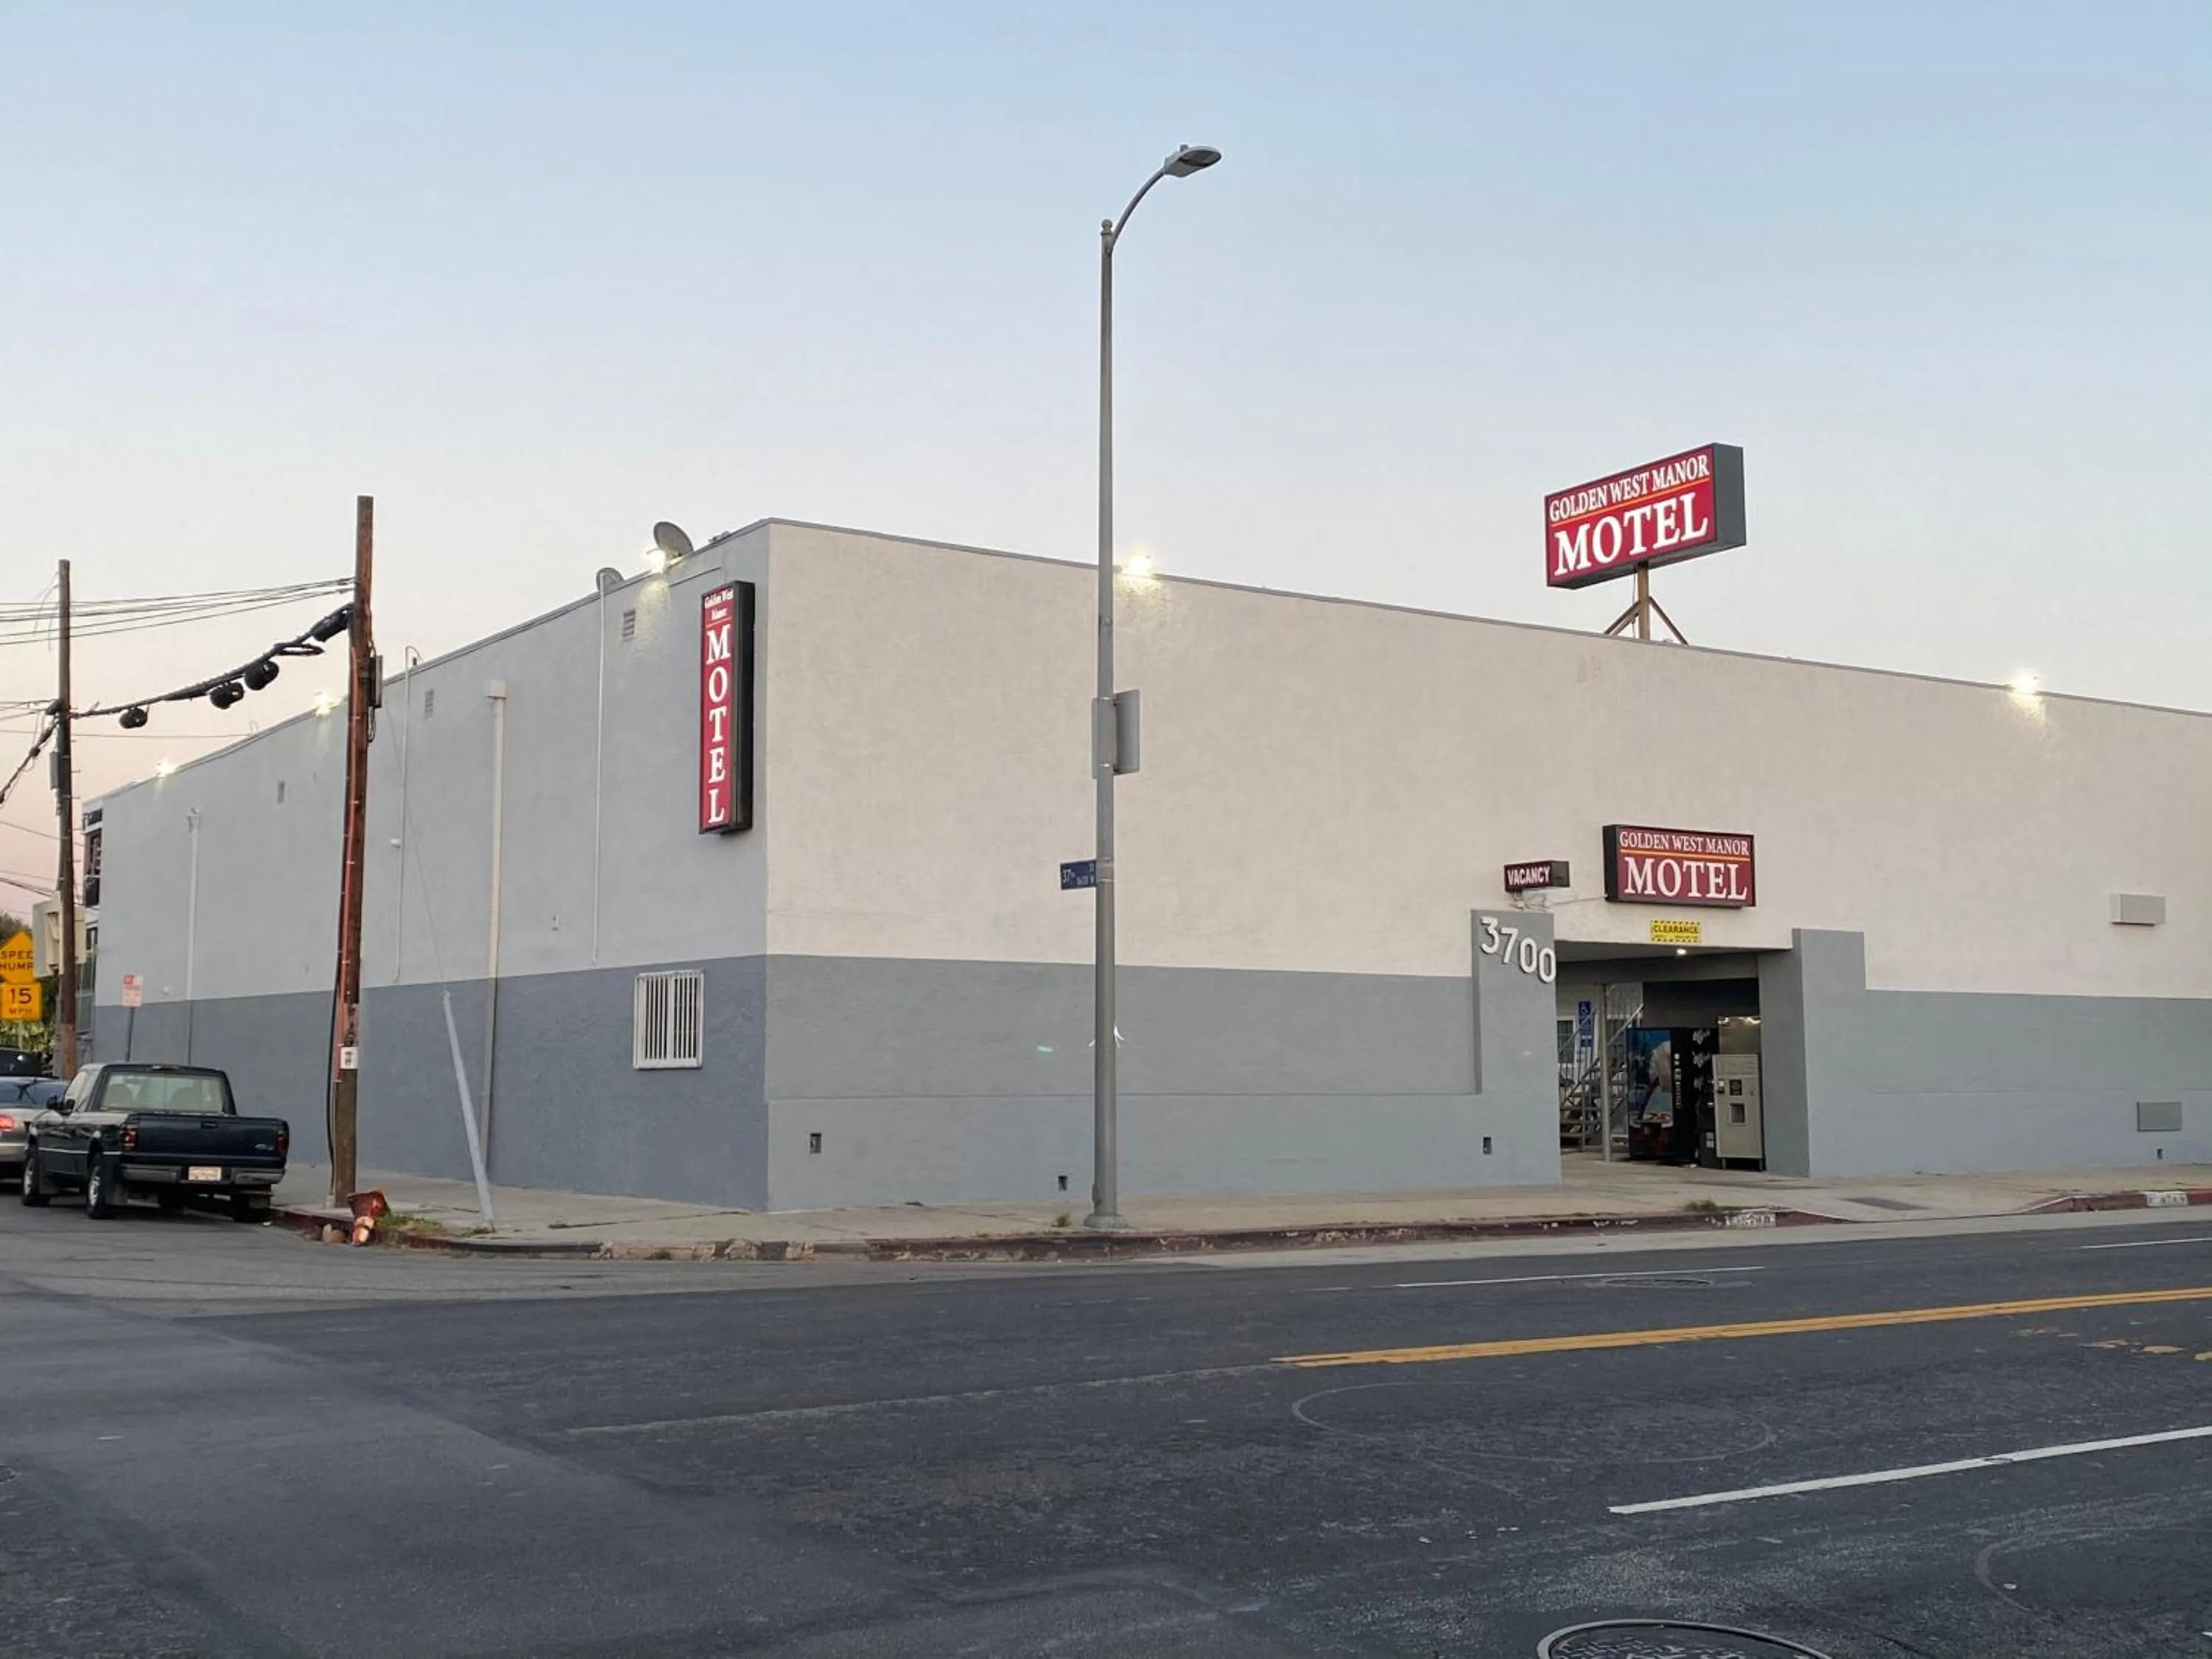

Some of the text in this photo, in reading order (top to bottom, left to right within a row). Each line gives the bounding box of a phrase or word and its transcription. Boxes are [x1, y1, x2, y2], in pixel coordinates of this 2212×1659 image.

[1550, 454, 1709, 522] GOLDEN WEST MANOR
[1554, 492, 1708, 576] MOTEL
[706, 624, 731, 824] MOTEL
[1620, 831, 1750, 855] GOLDEN WEST MANOR
[1507, 866, 1551, 886] VACANCY
[1624, 857, 1747, 900] MOTEL
[1653, 924, 1700, 934] CLEARANCE
[1, 950, 34, 959] SPEE
[1480, 916, 1557, 983] 3700
[10, 987, 32, 1004] 15
